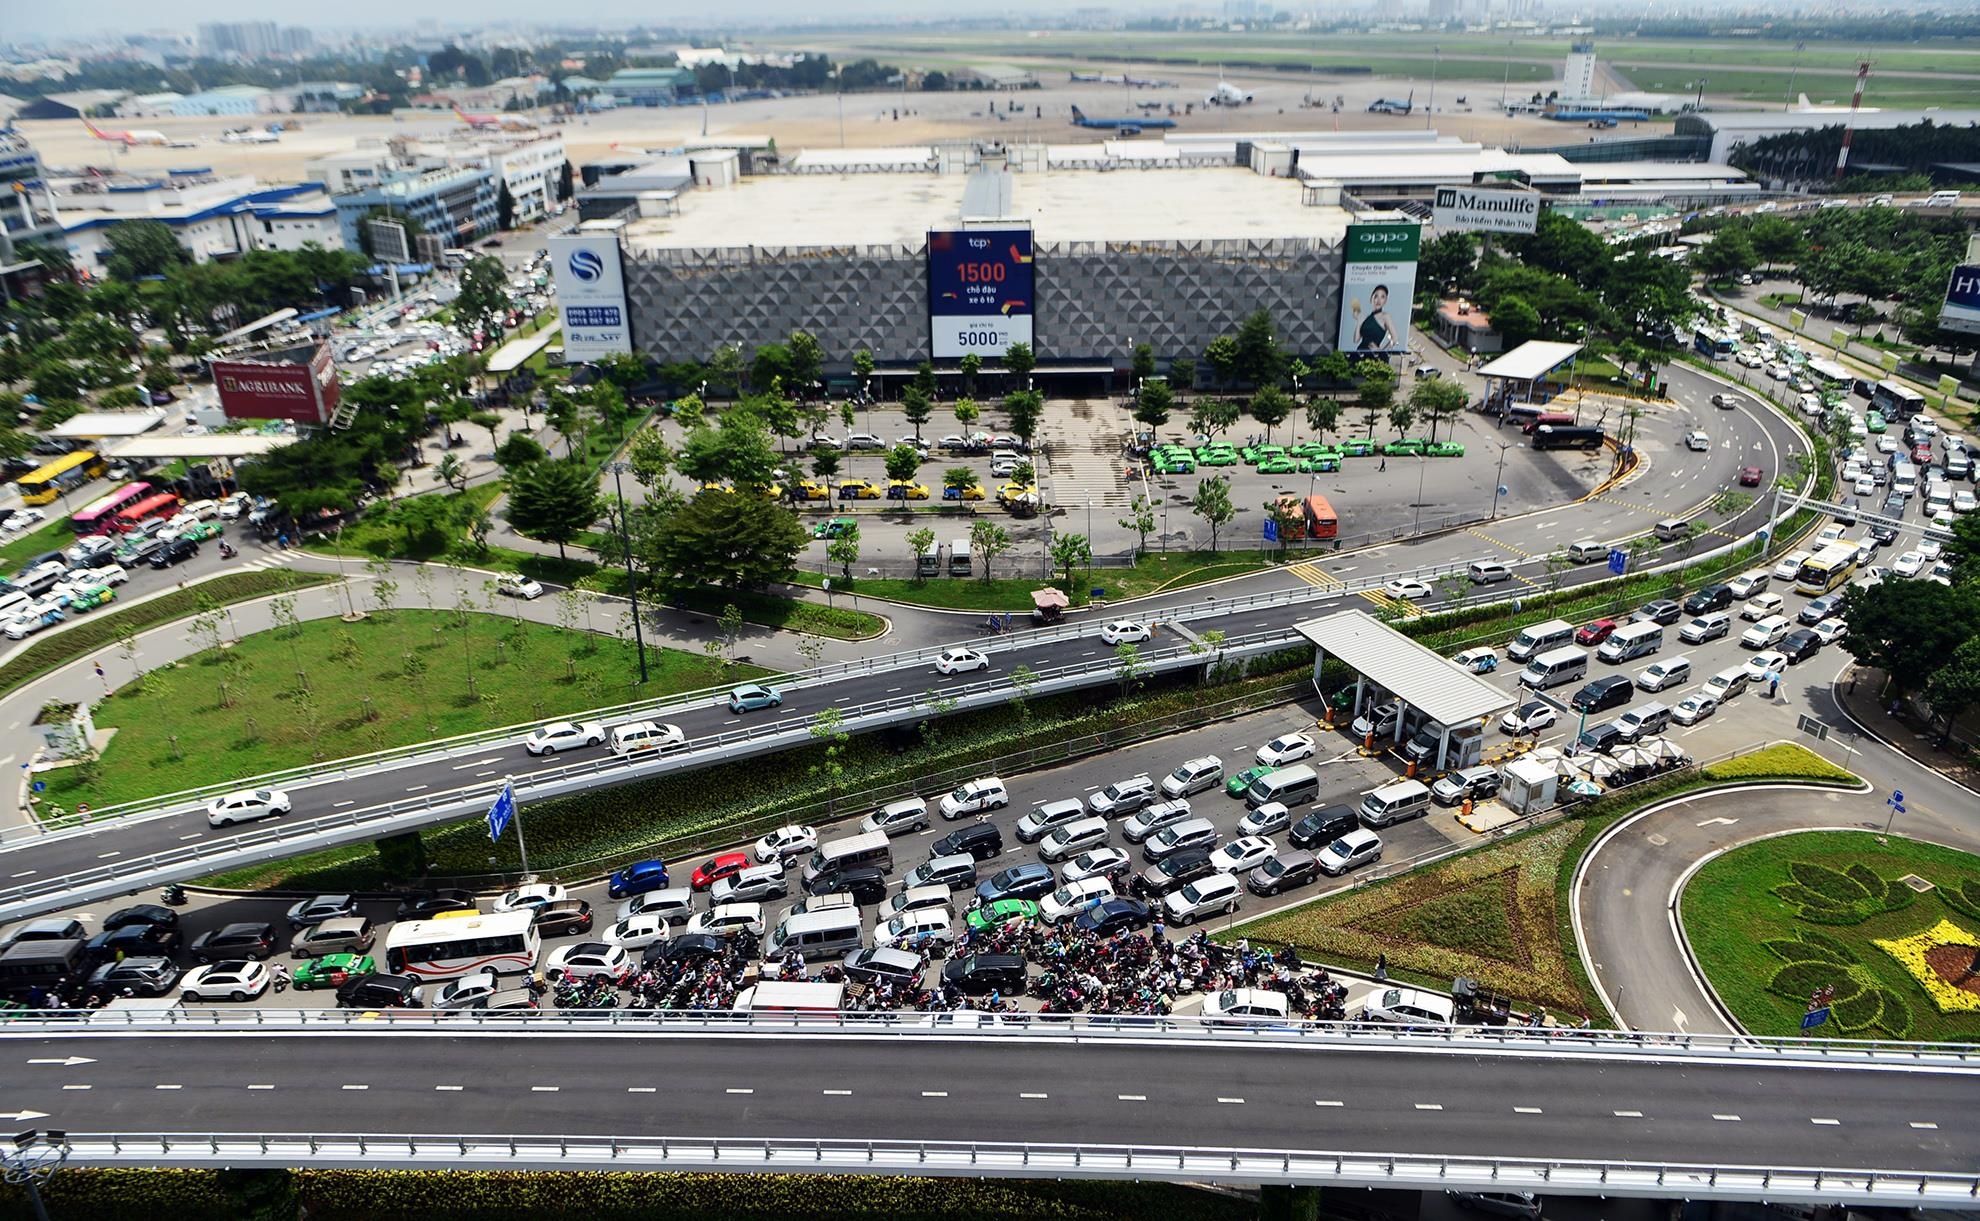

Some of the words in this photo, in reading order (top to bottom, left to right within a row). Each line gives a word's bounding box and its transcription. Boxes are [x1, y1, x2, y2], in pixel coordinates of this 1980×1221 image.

[1458, 194, 1534, 214] Manulife
[957, 262, 1006, 282] 1500
[959, 331, 998, 346] 5000
[239, 380, 307, 395] AGRIBANK
